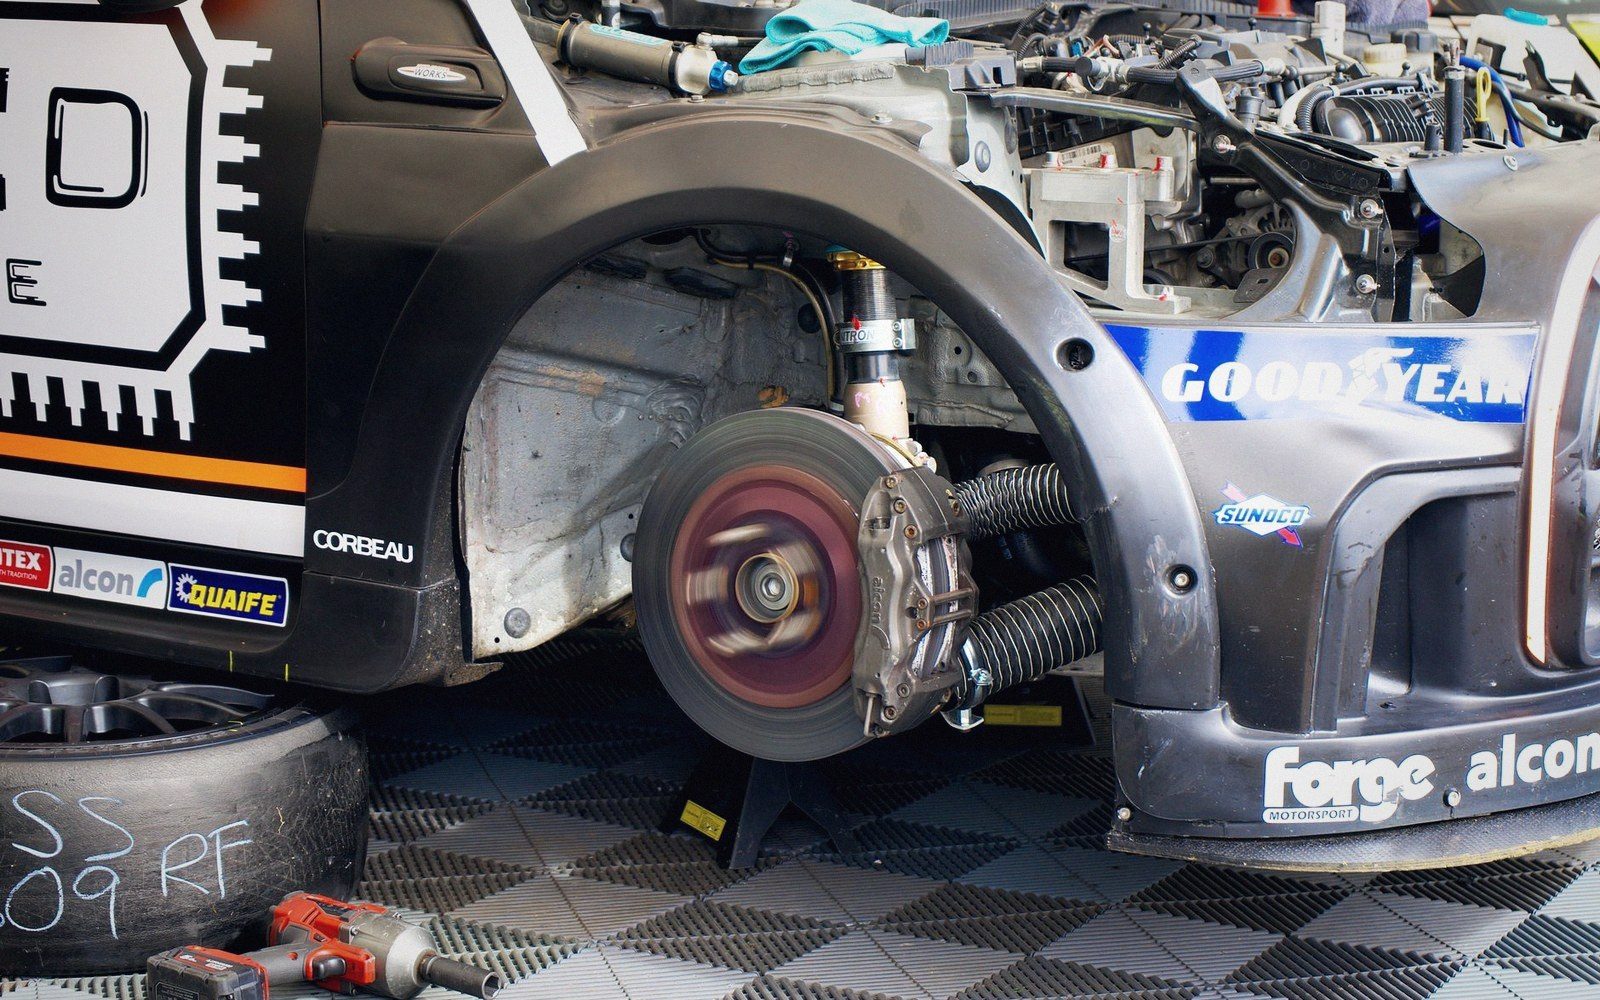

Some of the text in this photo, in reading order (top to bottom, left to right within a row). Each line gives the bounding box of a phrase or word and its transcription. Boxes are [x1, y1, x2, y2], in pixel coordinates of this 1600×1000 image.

[415, 69, 448, 79] WORKS
[1220, 507, 1306, 524] SUNOCO
[0, 548, 42, 571] TEX
[312, 529, 414, 564] CORBEAU
[58, 559, 134, 597] alcon
[188, 584, 278, 616] QUAIFE
[872, 576, 885, 624] alcon
[1466, 732, 1600, 791] alcon
[1263, 746, 1436, 822] forge
[12, 790, 134, 862] SS
[1268, 807, 1354, 822] MOTORSPORT
[161, 820, 252, 900] RF
[0, 865, 121, 940] 09
